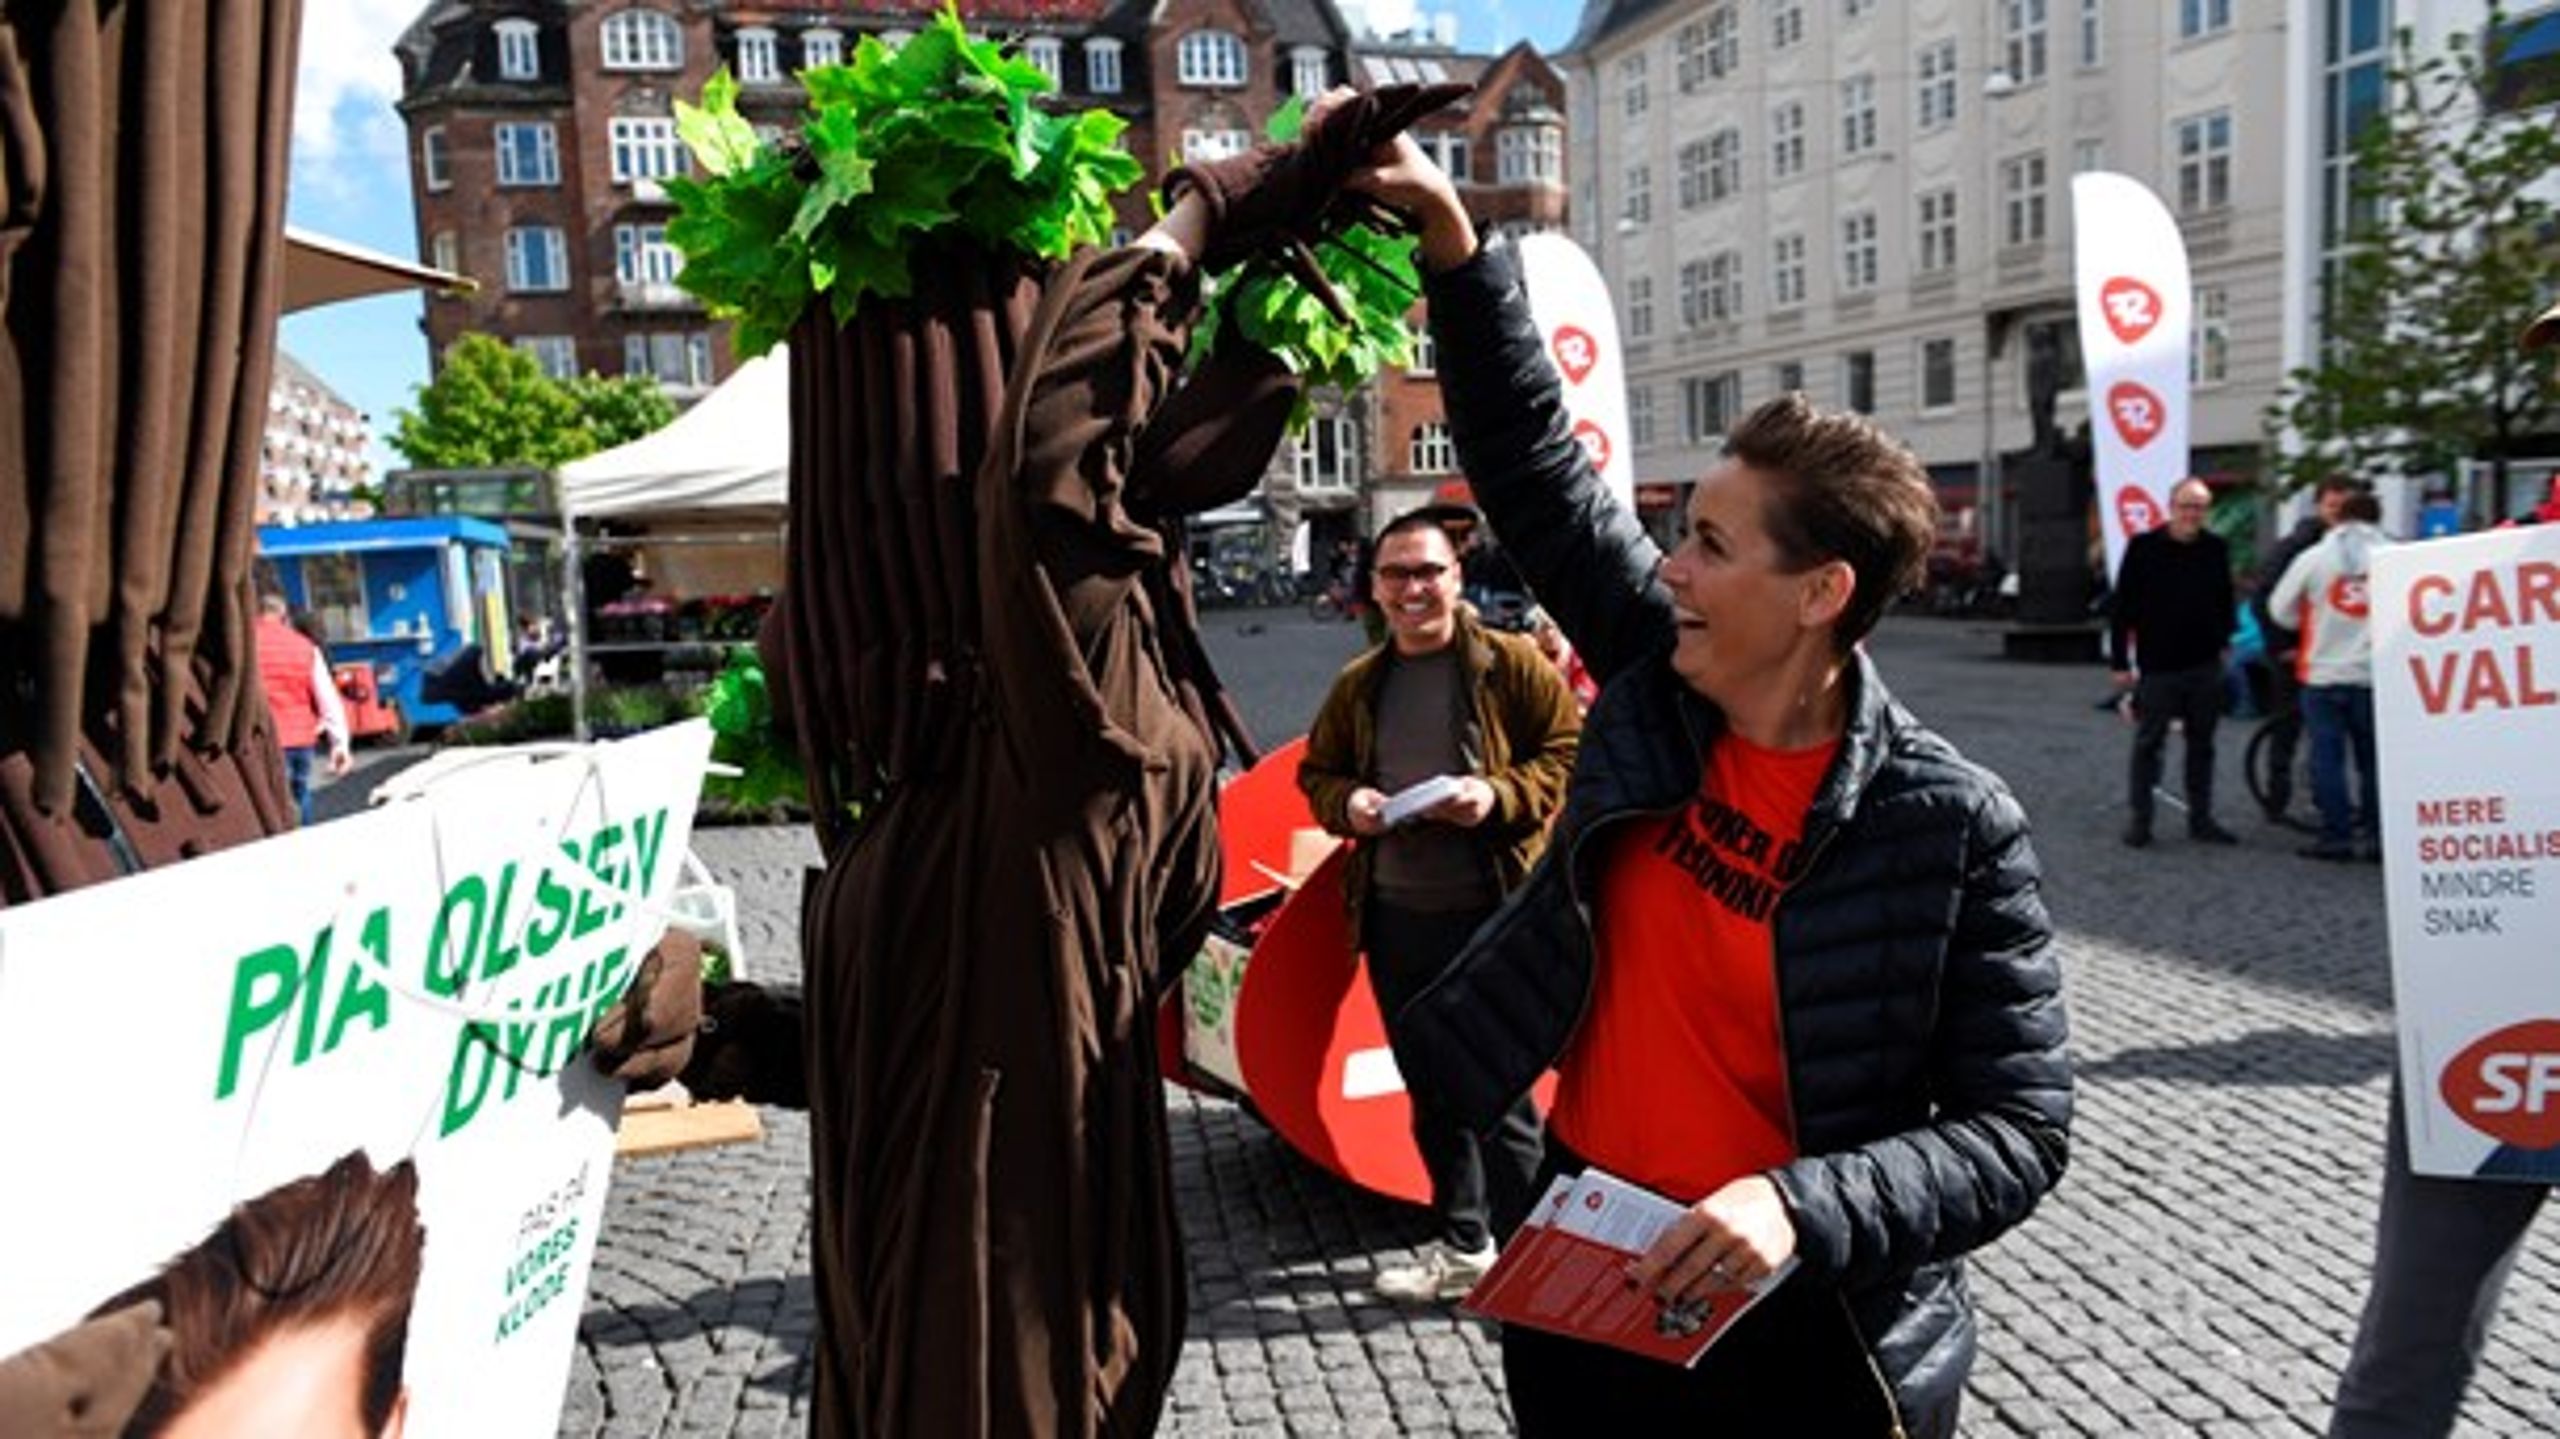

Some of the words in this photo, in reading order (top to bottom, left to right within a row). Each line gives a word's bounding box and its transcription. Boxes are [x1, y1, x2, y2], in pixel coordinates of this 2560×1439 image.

[2409, 561, 2560, 638] CAR
[2408, 645, 2558, 714] VAL
[2417, 797, 2506, 827] MERE
[2419, 830, 2560, 864] SOCIALIS
[2421, 868, 2536, 898] MINDRE
[215, 906, 391, 1100] PIA
[423, 807, 668, 1000] OLSEN
[2424, 906, 2503, 936] SNAK
[2473, 1053, 2560, 1115] SF
[506, 1217, 579, 1296] VORES
[494, 1261, 571, 1344] KLODE
